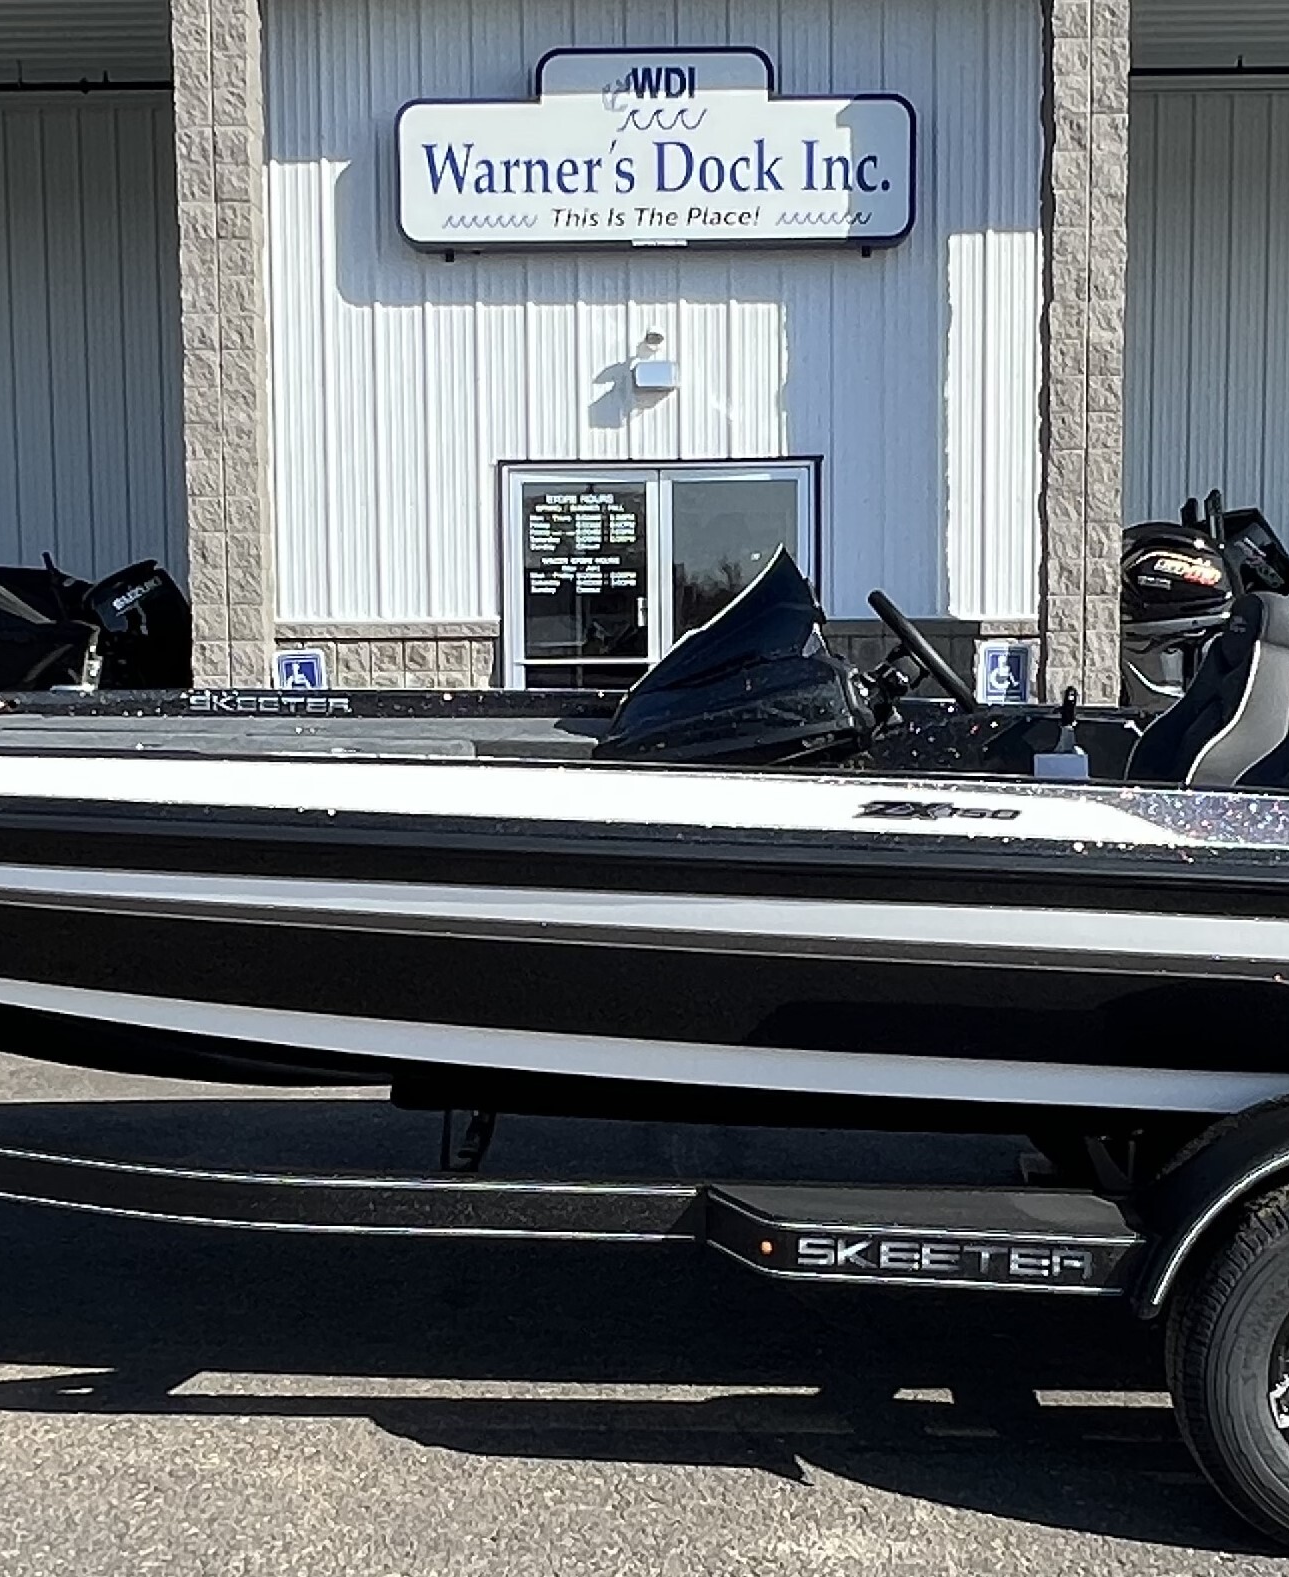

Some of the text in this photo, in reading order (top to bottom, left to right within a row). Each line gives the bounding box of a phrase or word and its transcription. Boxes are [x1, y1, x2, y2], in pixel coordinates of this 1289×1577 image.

[631, 66, 695, 99] WDI
[422, 138, 892, 195] Warner's Dock Inc.
[551, 205, 761, 229] This Is The Place!
[189, 694, 354, 714] SKEETER
[796, 1236, 1094, 1281] SKEETER
